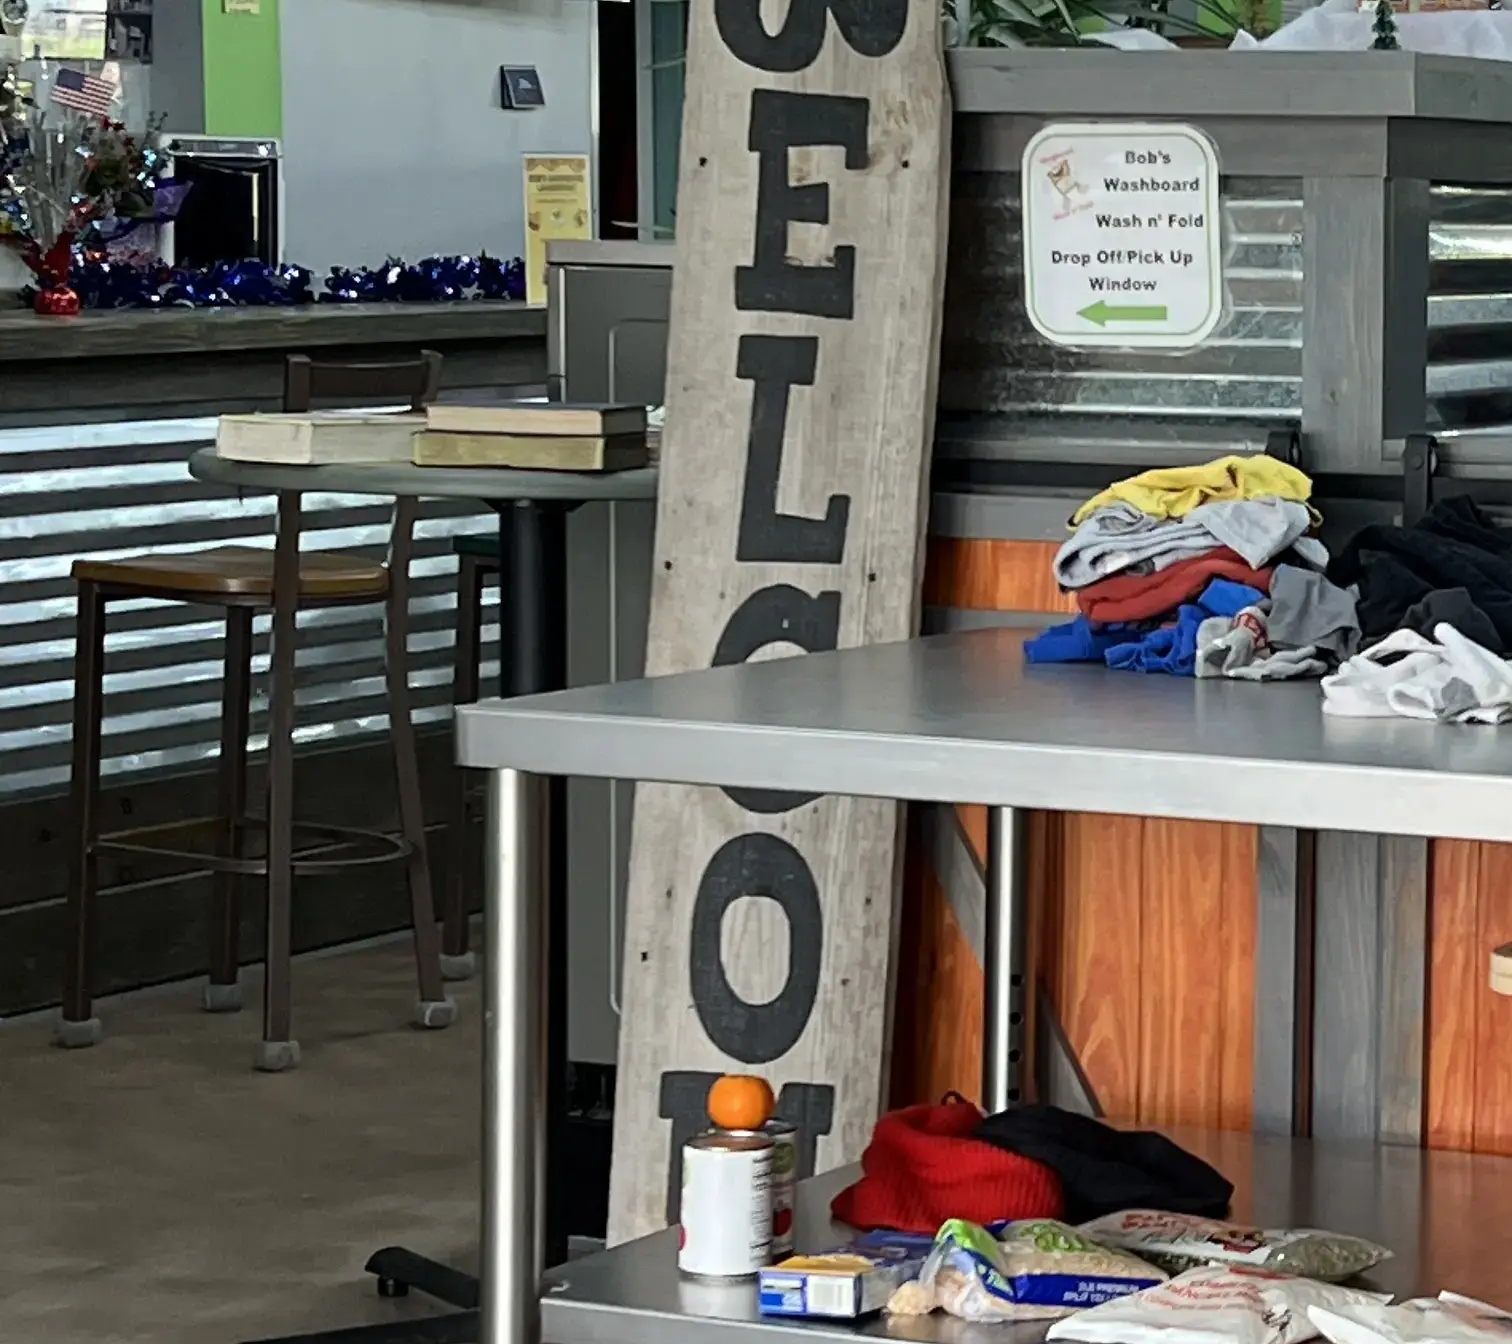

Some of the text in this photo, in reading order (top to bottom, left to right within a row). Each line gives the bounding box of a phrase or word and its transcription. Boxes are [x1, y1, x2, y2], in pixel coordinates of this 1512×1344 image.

[1125, 151, 1171, 164] Bob's
[1104, 178, 1200, 192] Washboard
[1096, 214, 1204, 228] Wash n' Fold
[1052, 251, 1091, 267] Drop
[1170, 251, 1193, 267] Up
[1089, 277, 1157, 291] Window
